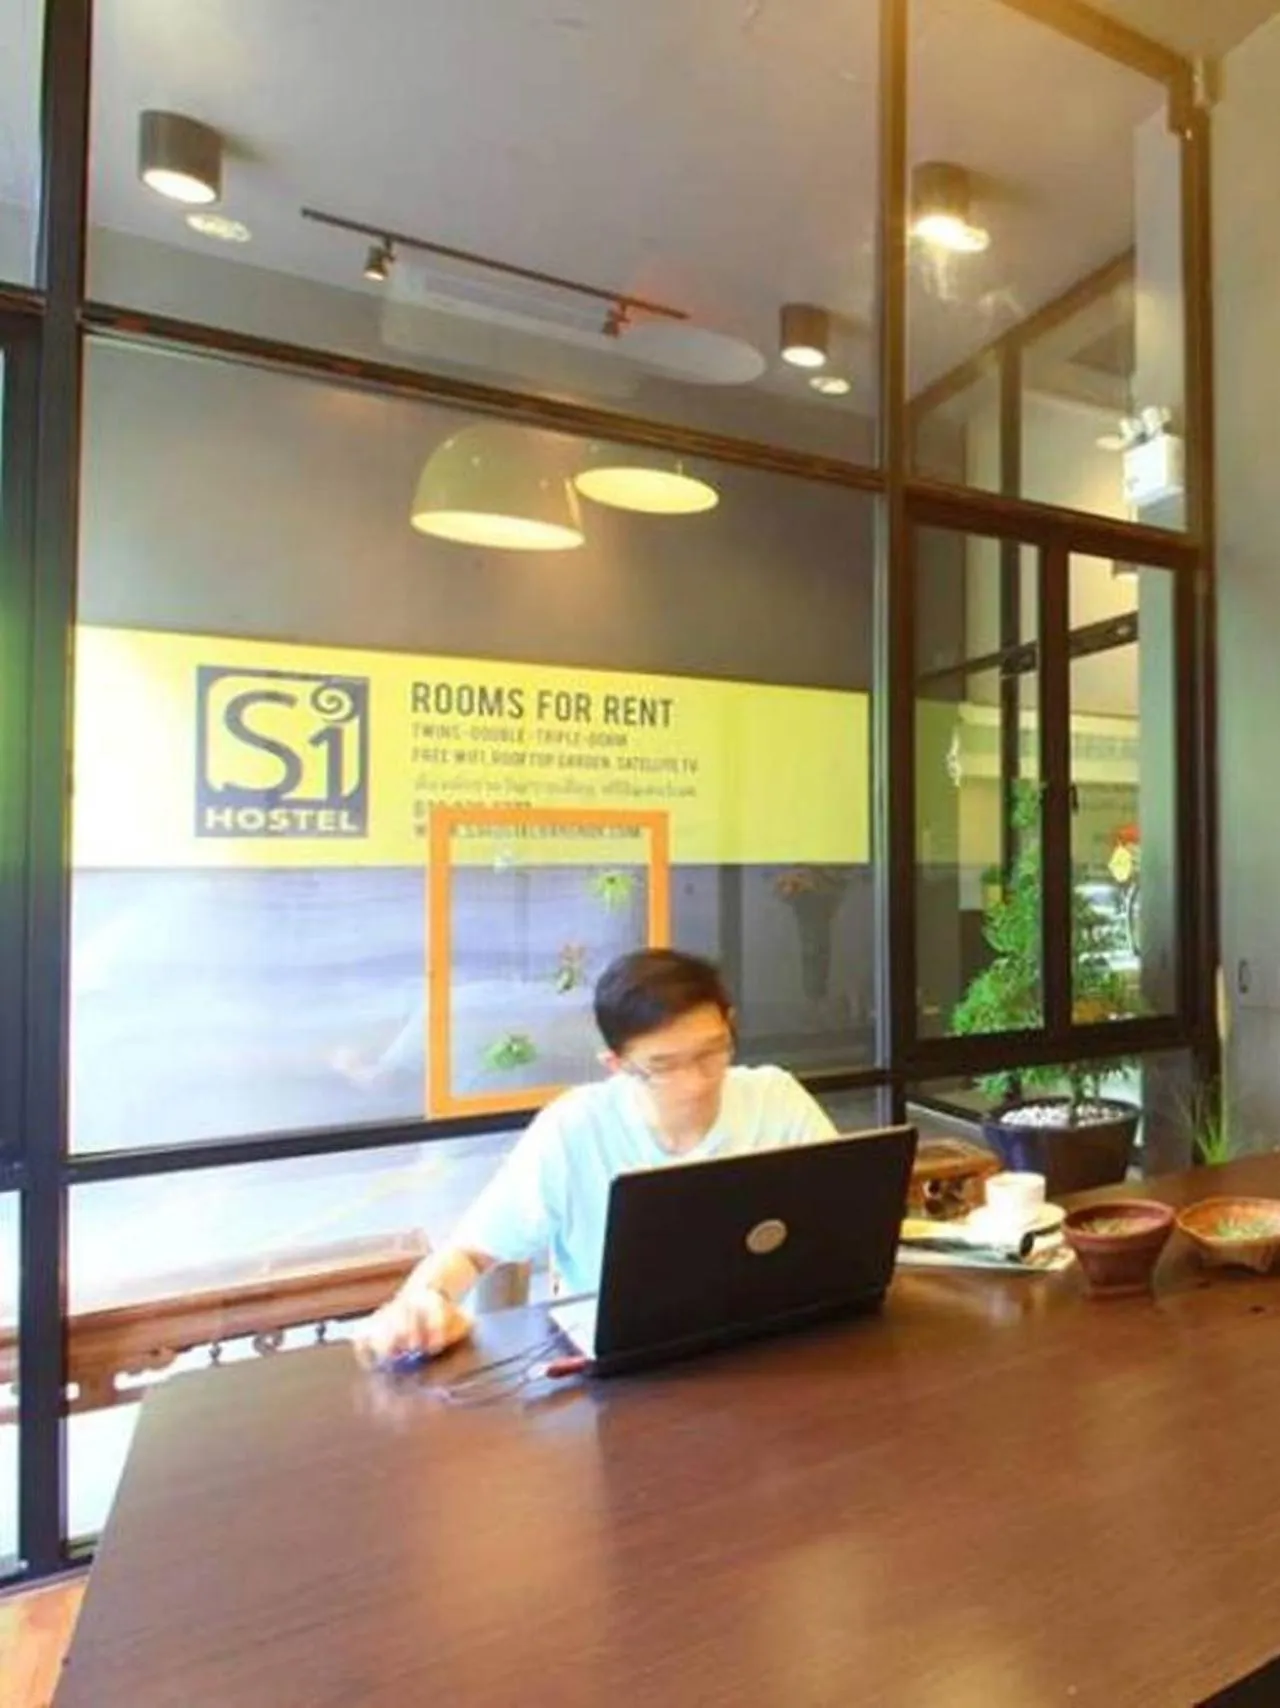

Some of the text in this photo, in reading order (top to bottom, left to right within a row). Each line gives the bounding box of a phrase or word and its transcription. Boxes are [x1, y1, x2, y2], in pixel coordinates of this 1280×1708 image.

[411, 681, 673, 728] ROOMS FOR RENT
[205, 806, 358, 834] HOSTEL
